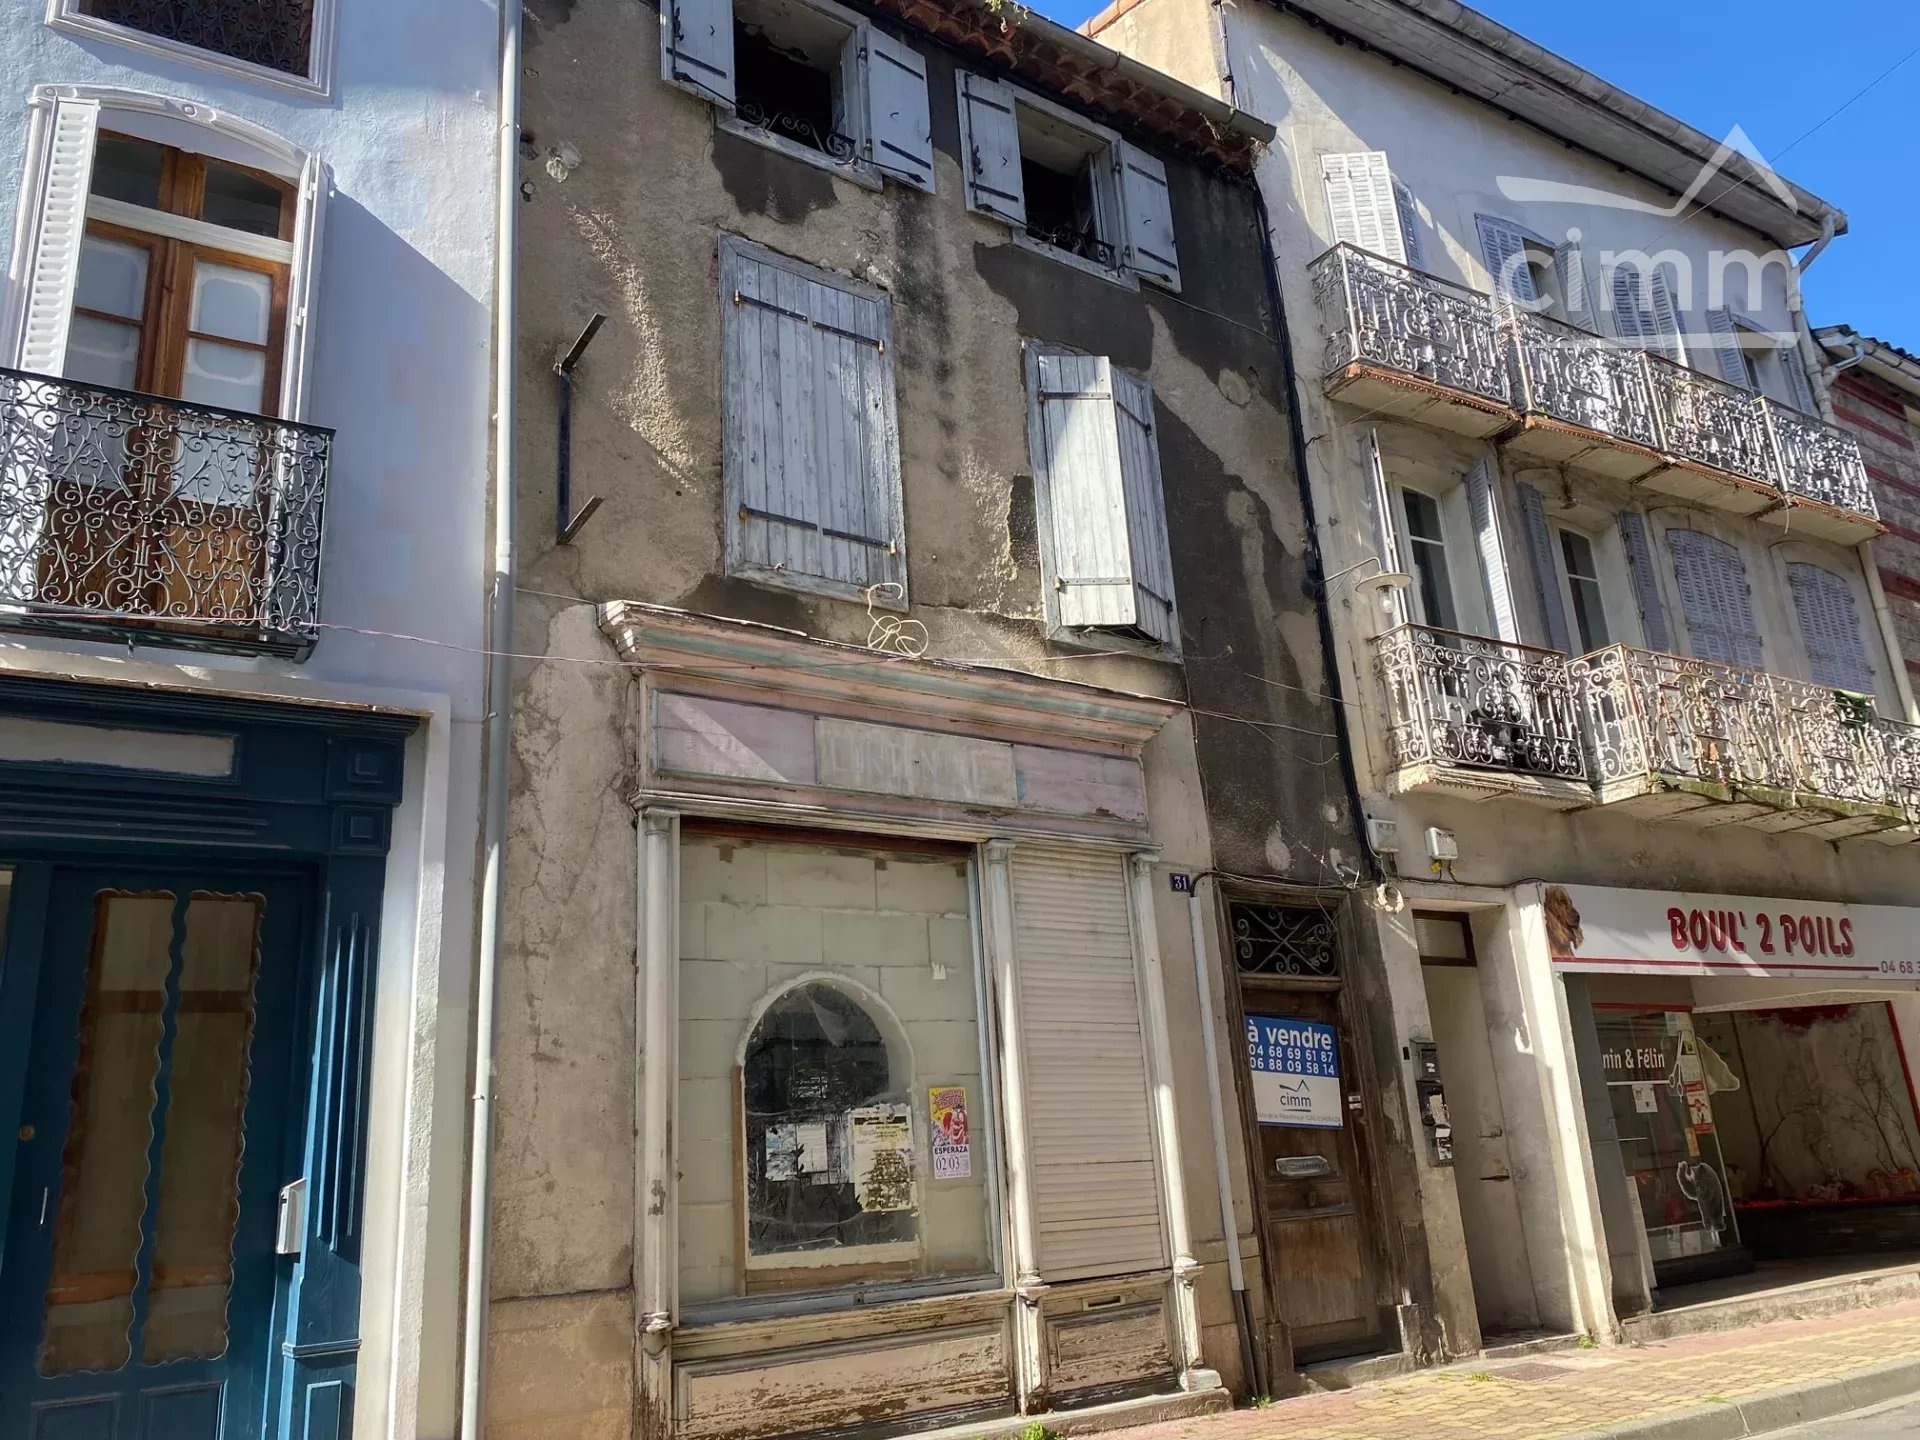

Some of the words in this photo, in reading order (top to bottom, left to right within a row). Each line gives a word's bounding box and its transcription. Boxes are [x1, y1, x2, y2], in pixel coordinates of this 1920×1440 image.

[1174, 875, 1187, 890] 31
[1667, 907, 1747, 952] BOUL'
[1756, 912, 1775, 954] 2
[1780, 913, 1855, 957] POILS
[1881, 960, 1896, 974] 04
[1899, 960, 1913, 974] 68
[1247, 1019, 1259, 1043] à
[1266, 1026, 1332, 1051] vendre
[1248, 1044, 1264, 1056] 04
[1268, 1046, 1283, 1058] 68
[1287, 1048, 1301, 1060] 69
[1305, 1049, 1317, 1062] 61
[1320, 1051, 1333, 1063] 87
[1625, 1048, 1635, 1069] &
[1637, 1048, 1666, 1069] Félin
[1249, 1057, 1264, 1069] 06
[1268, 1058, 1283, 1071] 88
[1287, 1060, 1302, 1073] 09
[1306, 1062, 1319, 1074] 58
[1322, 1063, 1335, 1076] 14
[1280, 1093, 1312, 1107] cimm
[934, 1145, 968, 1155] ESPERAZA
[935, 1157, 947, 1171] 02
[948, 1156, 960, 1170] 03
